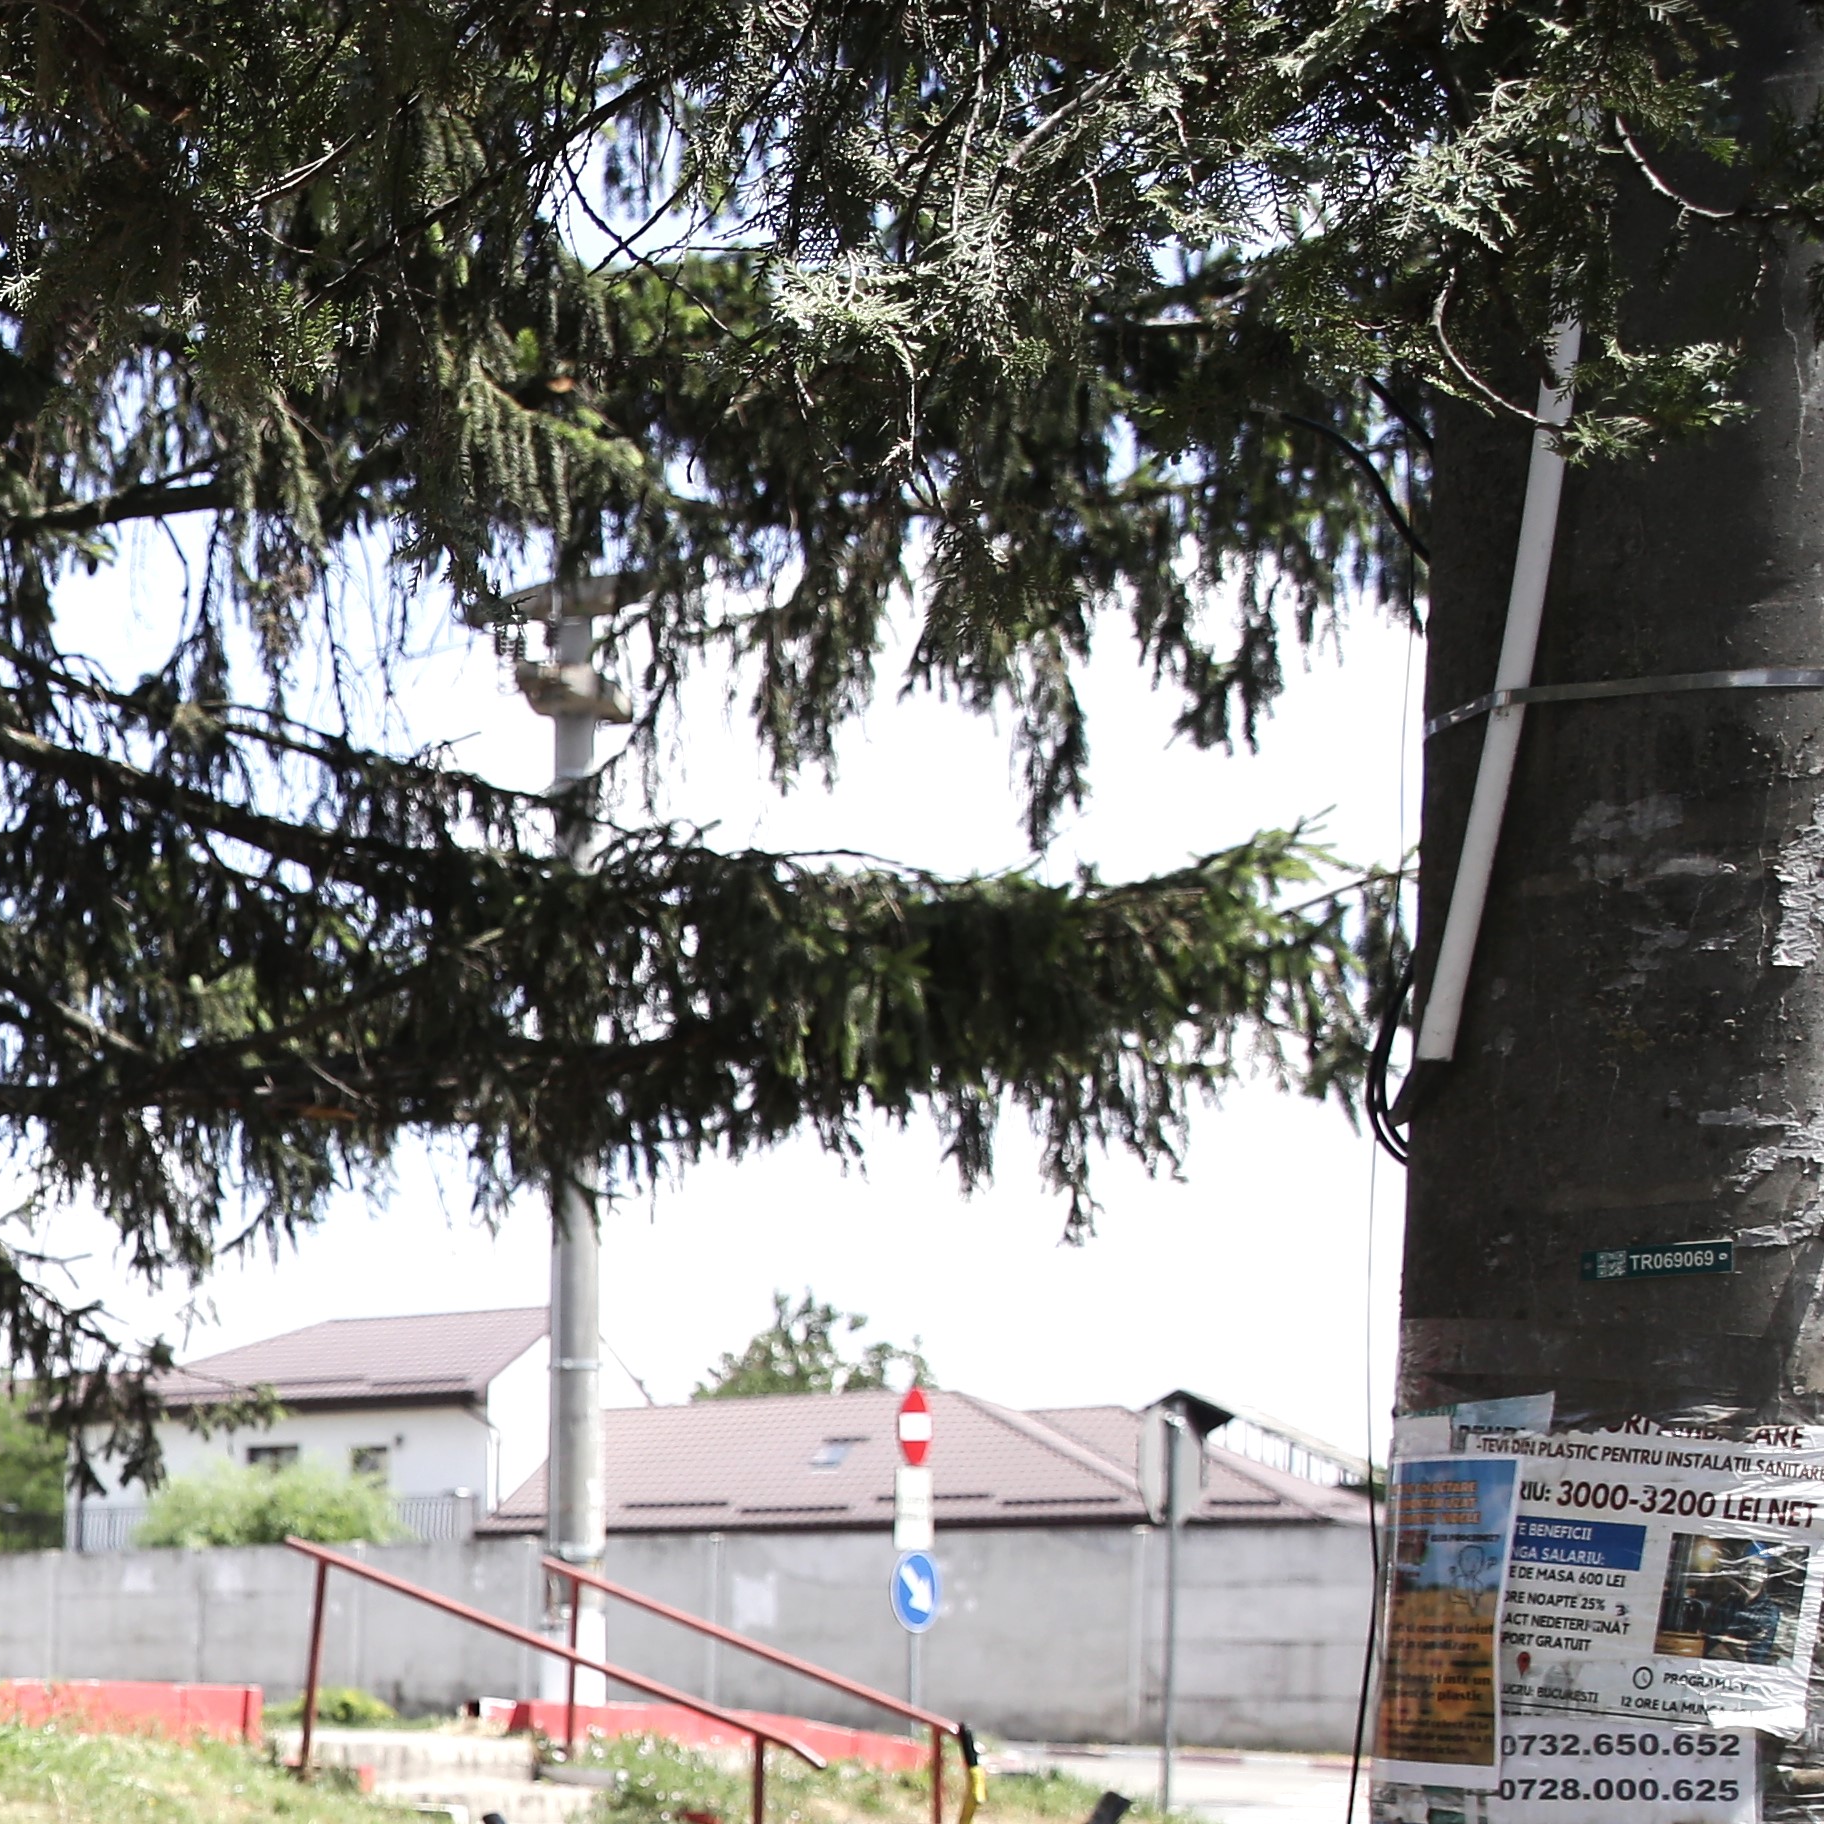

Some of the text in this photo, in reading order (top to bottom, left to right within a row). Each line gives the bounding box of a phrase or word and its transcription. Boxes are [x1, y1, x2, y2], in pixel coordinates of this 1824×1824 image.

[1629, 1250, 1714, 1271] TR069069
[1510, 1439, 1536, 1455] DIN
[1539, 1441, 1598, 1460] PLASTIC
[1602, 1446, 1661, 1466] PENTRU
[1556, 1480, 1715, 1519] 3000-3200
[1721, 1494, 1763, 1522] LEI
[1766, 1498, 1819, 1529] NET
[1529, 1523, 1593, 1541] BENEFICII
[1541, 1547, 1605, 1566] SALARIU:
[1518, 1566, 1533, 1579] DE
[1535, 1568, 1575, 1583] MASA
[1578, 1572, 1603, 1586] 600
[1606, 1574, 1627, 1588] LEI
[1527, 1592, 1577, 1609] NOAPTE
[1580, 1598, 1606, 1612] 25%
[1535, 1634, 1592, 1651] GRATUIT
[1620, 1695, 1632, 1707] 12
[1634, 1697, 1660, 1711] ORE
[1662, 1700, 1678, 1712] LA
[1501, 1733, 1740, 1757] 0732.650.652
[1500, 1778, 1740, 1801] 0728.000.625
